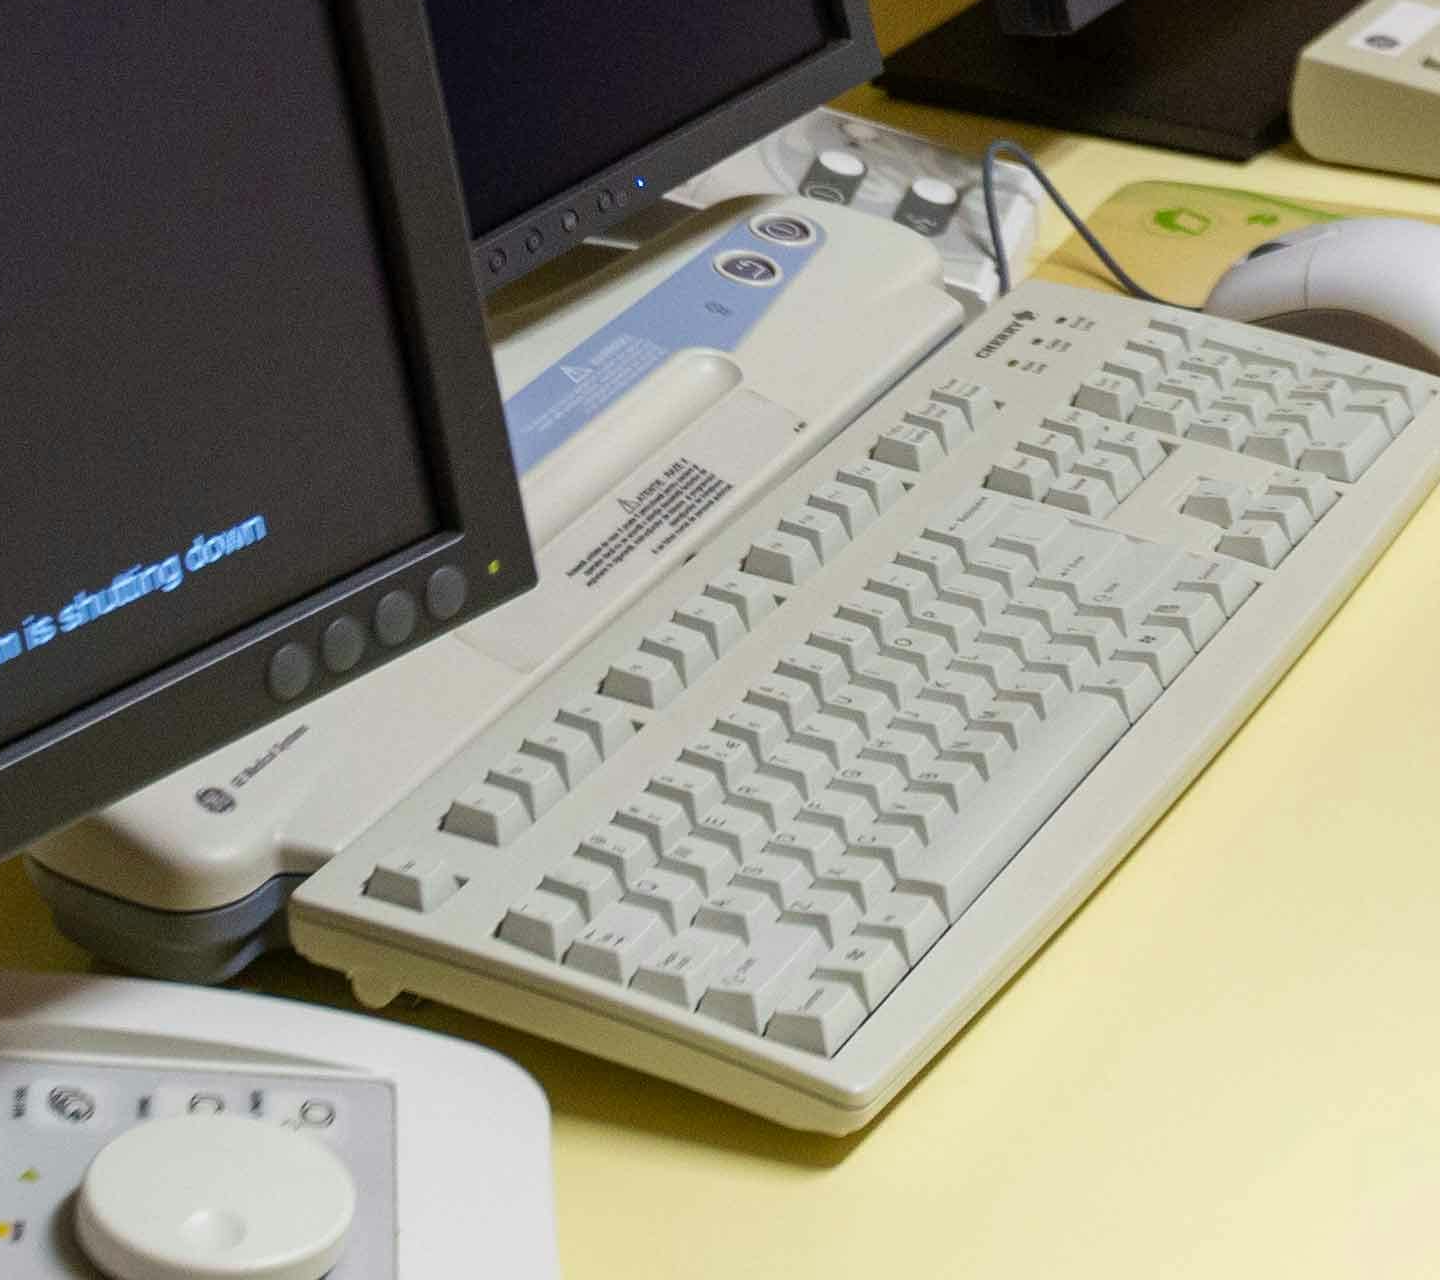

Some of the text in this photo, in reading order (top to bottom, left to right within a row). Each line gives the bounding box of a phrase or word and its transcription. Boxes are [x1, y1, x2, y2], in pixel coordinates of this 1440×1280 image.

[21, 613, 58, 651] is
[58, 562, 186, 634] shutting
[183, 513, 269, 574] down
